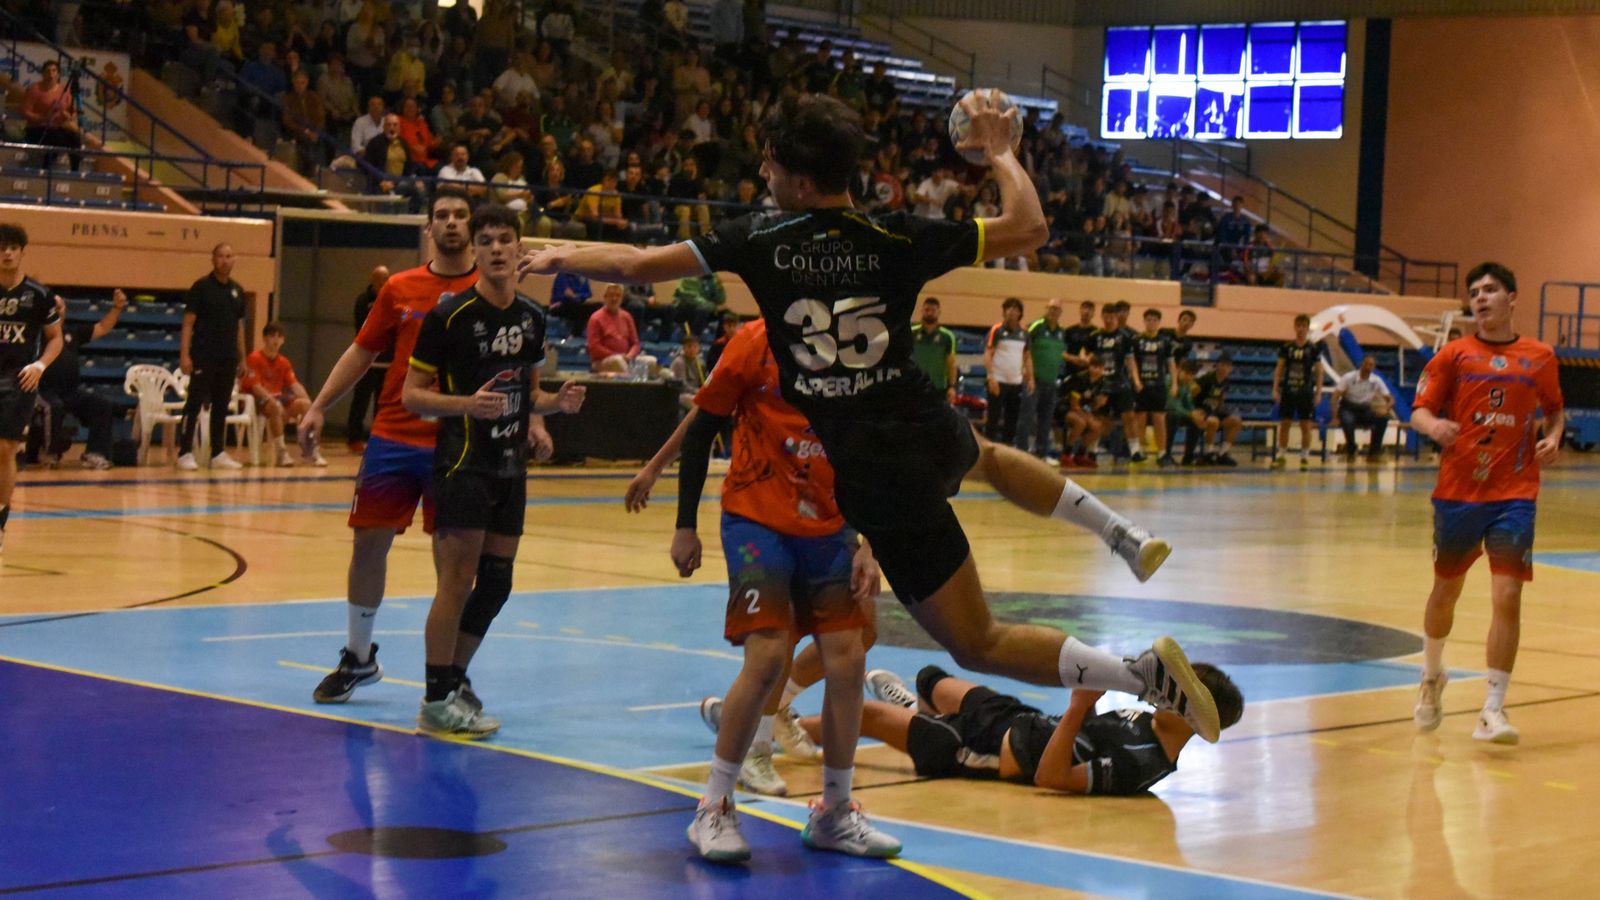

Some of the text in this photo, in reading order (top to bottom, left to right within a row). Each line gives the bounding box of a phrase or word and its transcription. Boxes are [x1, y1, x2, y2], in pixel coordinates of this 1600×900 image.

[71, 222, 128, 238] PRENSA
[181, 227, 199, 240] TV
[774, 244, 881, 273] COLOMER
[800, 241, 854, 254] GRUPO
[791, 271, 863, 286] DENTAL
[491, 325, 524, 356] 49
[783, 296, 890, 371] 35
[1488, 387, 1505, 408] 9
[744, 588, 761, 615] 2
